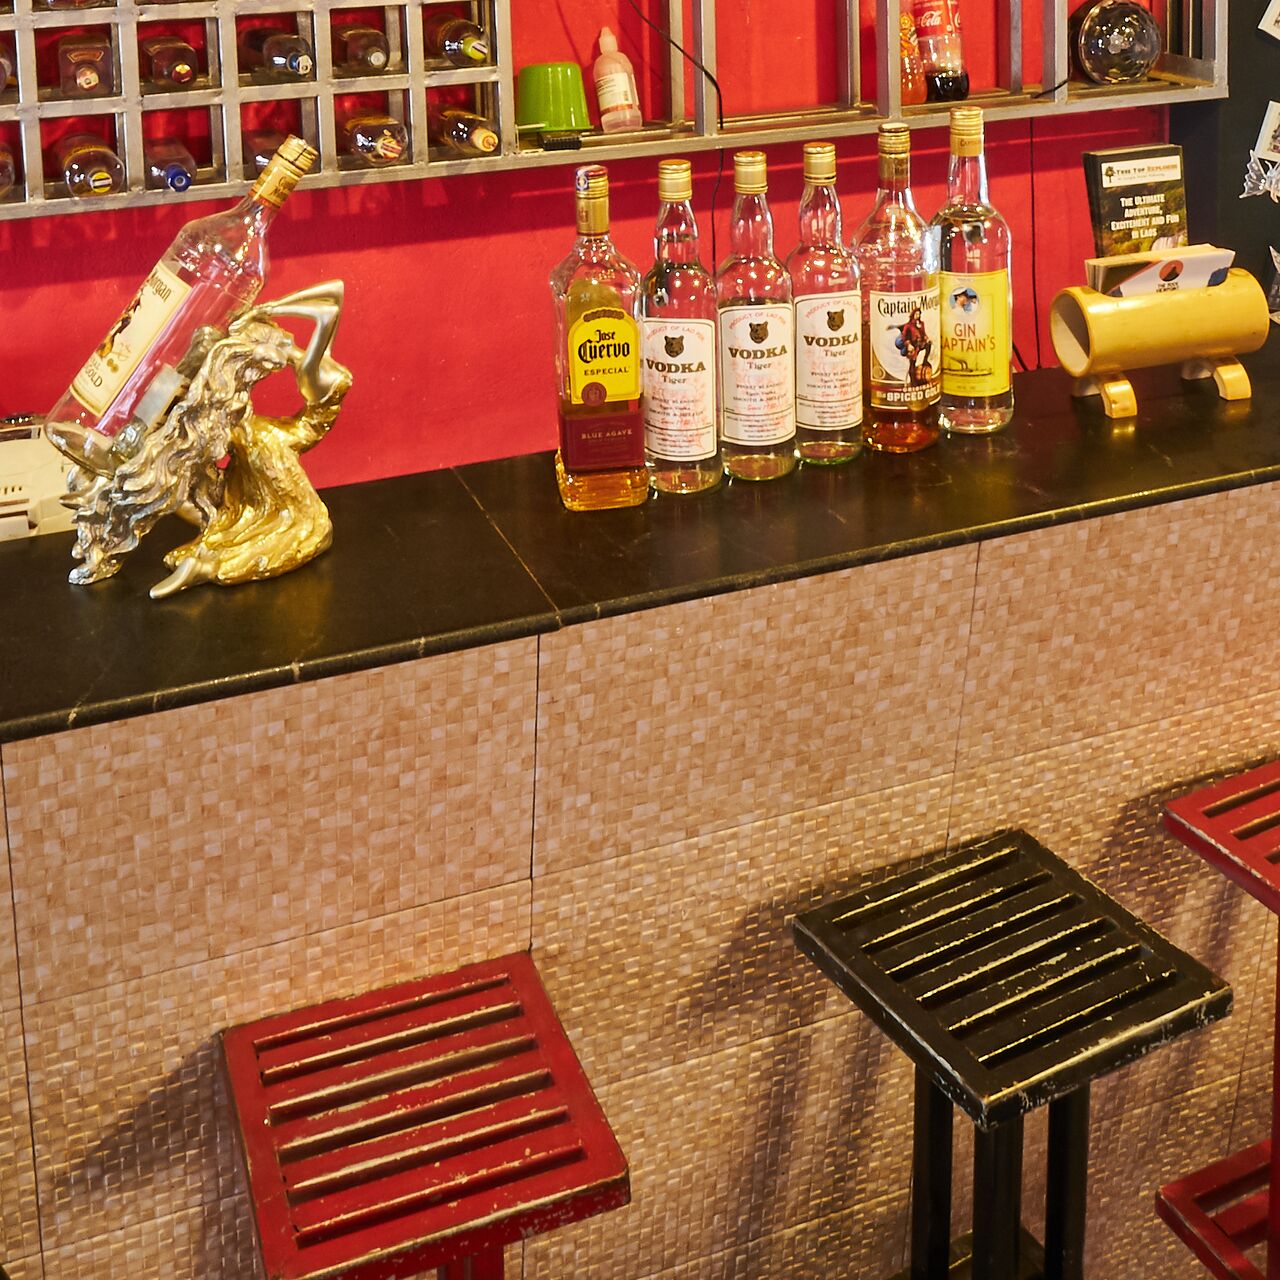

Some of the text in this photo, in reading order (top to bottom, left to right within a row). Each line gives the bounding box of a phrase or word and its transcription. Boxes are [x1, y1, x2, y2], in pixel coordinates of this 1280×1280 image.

[877, 297, 918, 317] Captain
[594, 329, 616, 345] Jose
[954, 322, 977, 337] GIN
[803, 332, 859, 348] VODKA
[577, 339, 631, 365] Cuervo
[728, 345, 788, 360] VODKA
[823, 348, 847, 358] Tiger
[584, 367, 630, 377] ESPECIAL
[645, 357, 707, 375] VODKA
[746, 360, 772, 371] Tiger
[661, 374, 688, 385] Tiger
[886, 389, 924, 402] SPICED
[581, 431, 603, 440] BLUE
